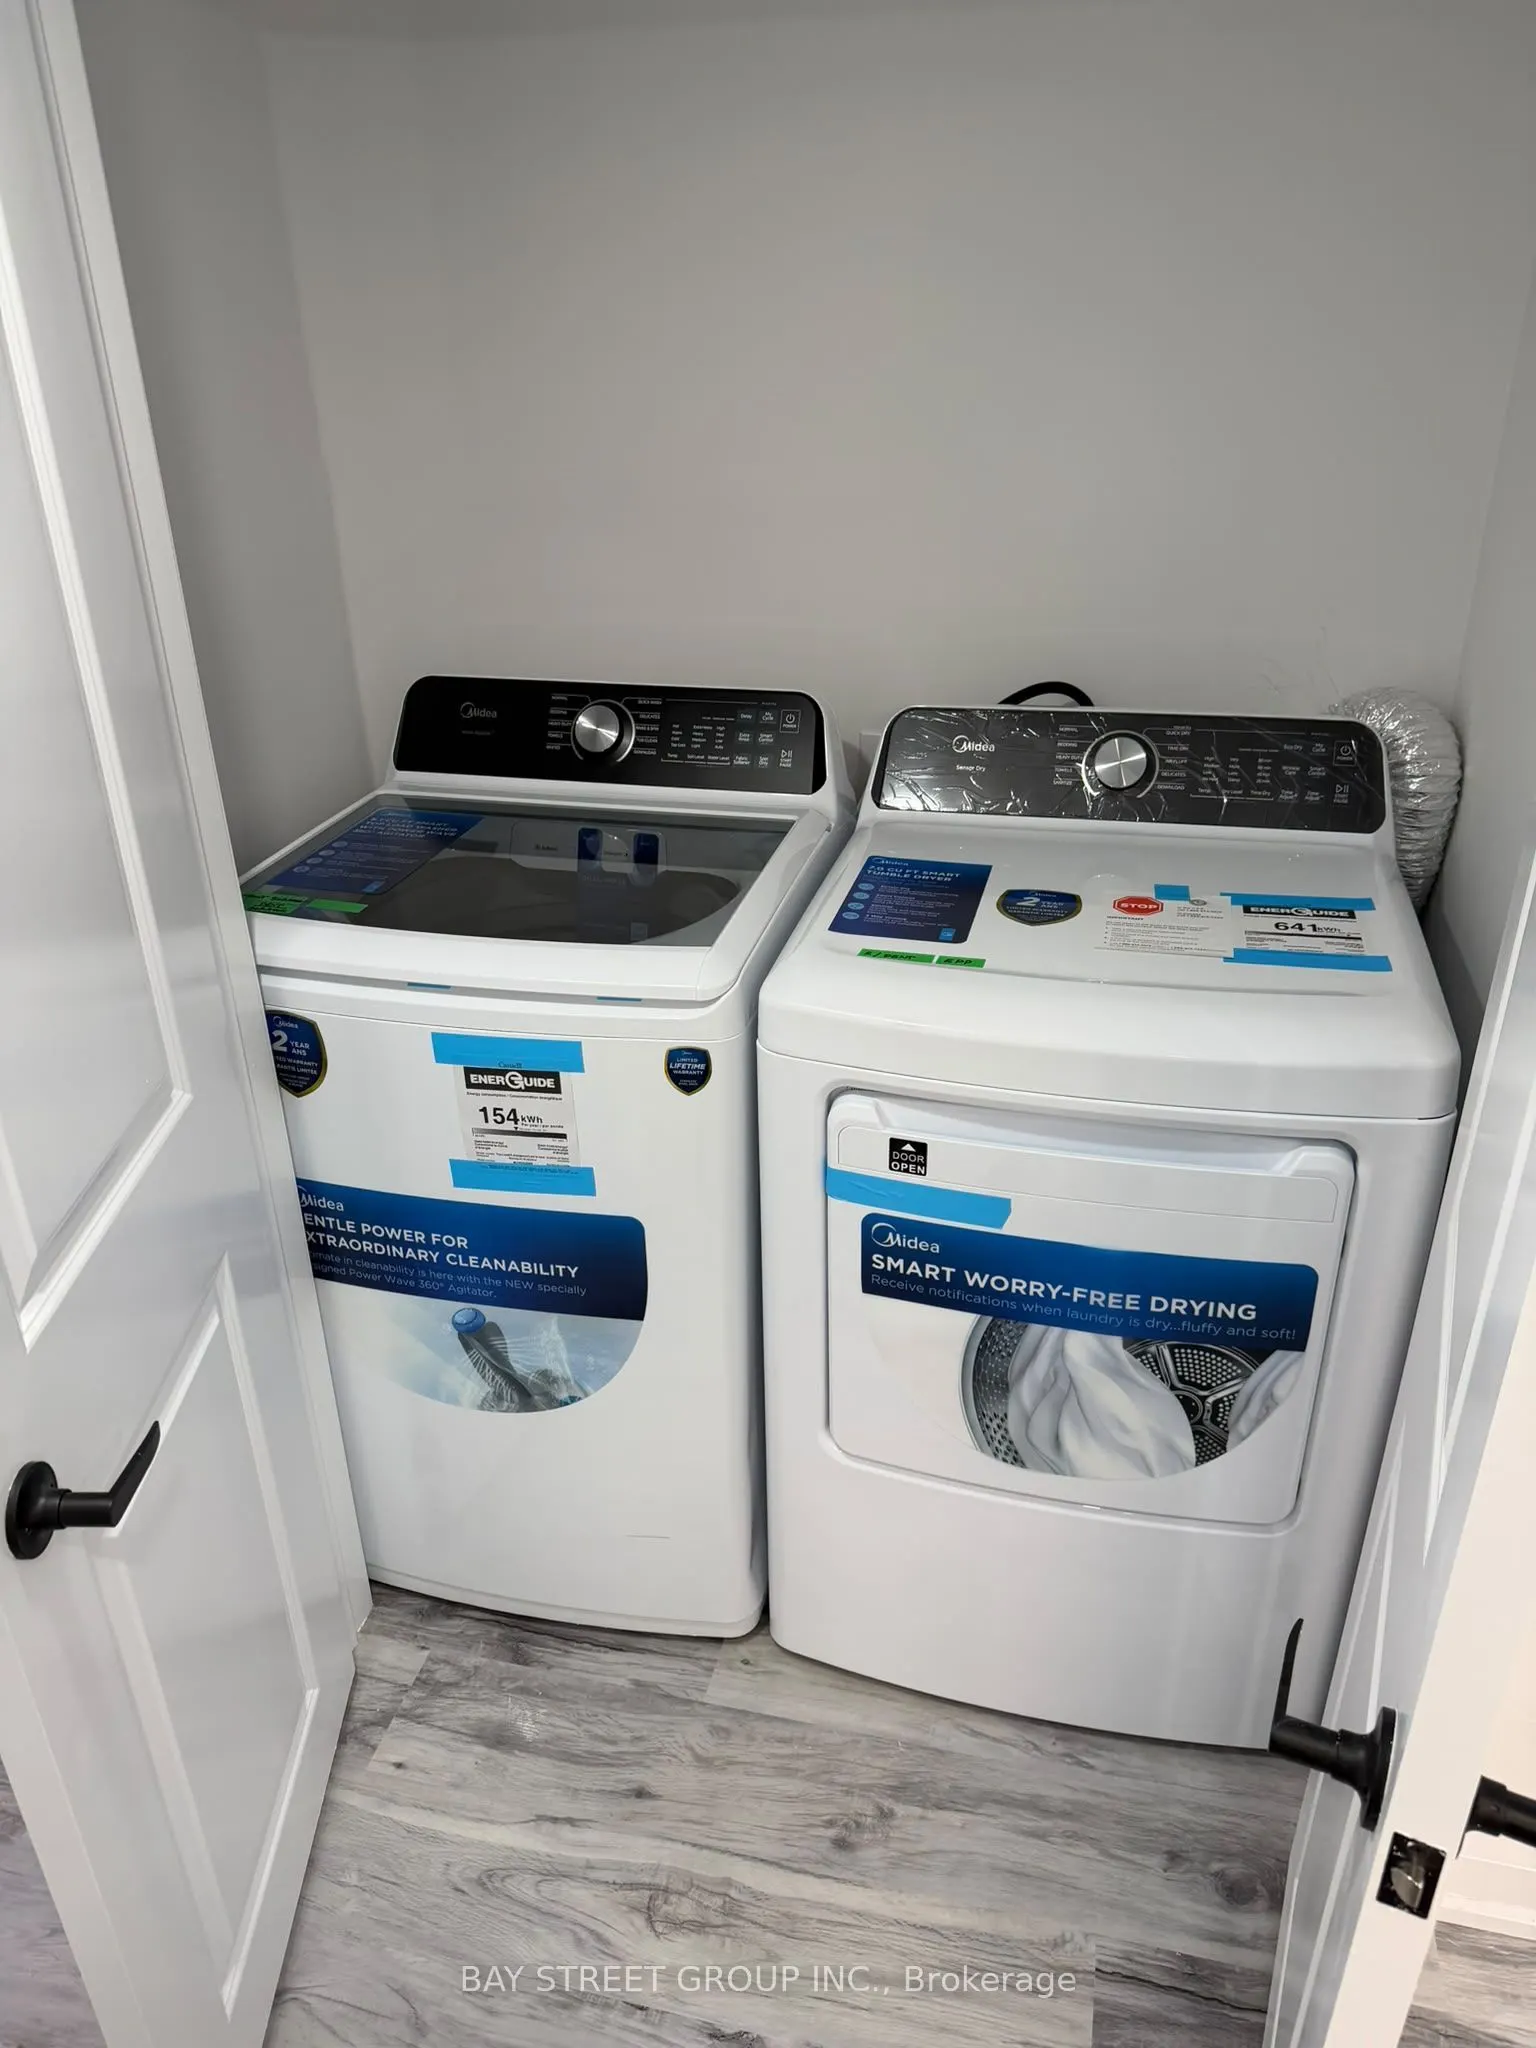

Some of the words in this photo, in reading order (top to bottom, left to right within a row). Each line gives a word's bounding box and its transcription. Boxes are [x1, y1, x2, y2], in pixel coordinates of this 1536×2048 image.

[460, 702, 498, 718] Midea
[952, 735, 995, 752] Midea
[865, 869, 911, 878] TUMBLE
[913, 874, 953, 882] DRYER
[921, 870, 962, 878] SMART
[1016, 896, 1041, 906] 2
[1119, 902, 1159, 910] STOP
[1249, 906, 1350, 918] ENERGUIDE
[1273, 920, 1318, 933] 641
[271, 1029, 288, 1052] 2
[289, 1040, 310, 1050] YEAR
[291, 1047, 307, 1056] ANS
[670, 1062, 706, 1070] LIFETIME
[470, 1071, 556, 1090] ENERGUIDE
[478, 1106, 520, 1125] 154
[520, 1115, 544, 1124] kWh
[892, 1151, 925, 1164] DOOR
[891, 1161, 925, 1175] OPEN
[299, 1187, 345, 1212] Midea
[303, 1213, 357, 1233] ENTLE
[360, 1222, 426, 1244] POWER
[431, 1233, 469, 1249] FOR
[871, 1222, 940, 1254] Midea
[306, 1231, 440, 1264] XTRAORDINARY
[446, 1253, 579, 1278] CLEANABILITY
[344, 1256, 353, 1265] in
[355, 1259, 415, 1278] cleanability
[418, 1269, 427, 1278] is
[429, 1271, 454, 1281] here
[456, 1274, 481, 1284] with
[483, 1276, 502, 1287] the
[505, 1279, 534, 1290] NEW
[537, 1283, 587, 1297] specially
[349, 1269, 381, 1282] Power
[871, 1253, 956, 1283] SMART
[964, 1269, 1141, 1311] WORRY-FREE
[1149, 1295, 1257, 1320] DRYING
[871, 1273, 925, 1293] Receive
[928, 1285, 1017, 1310] notifications
[1022, 1301, 1062, 1317] when
[1067, 1307, 1124, 1328] laundry
[1129, 1315, 1140, 1327] is
[1226, 1326, 1257, 1338] and
[1261, 1328, 1296, 1341] soft!
